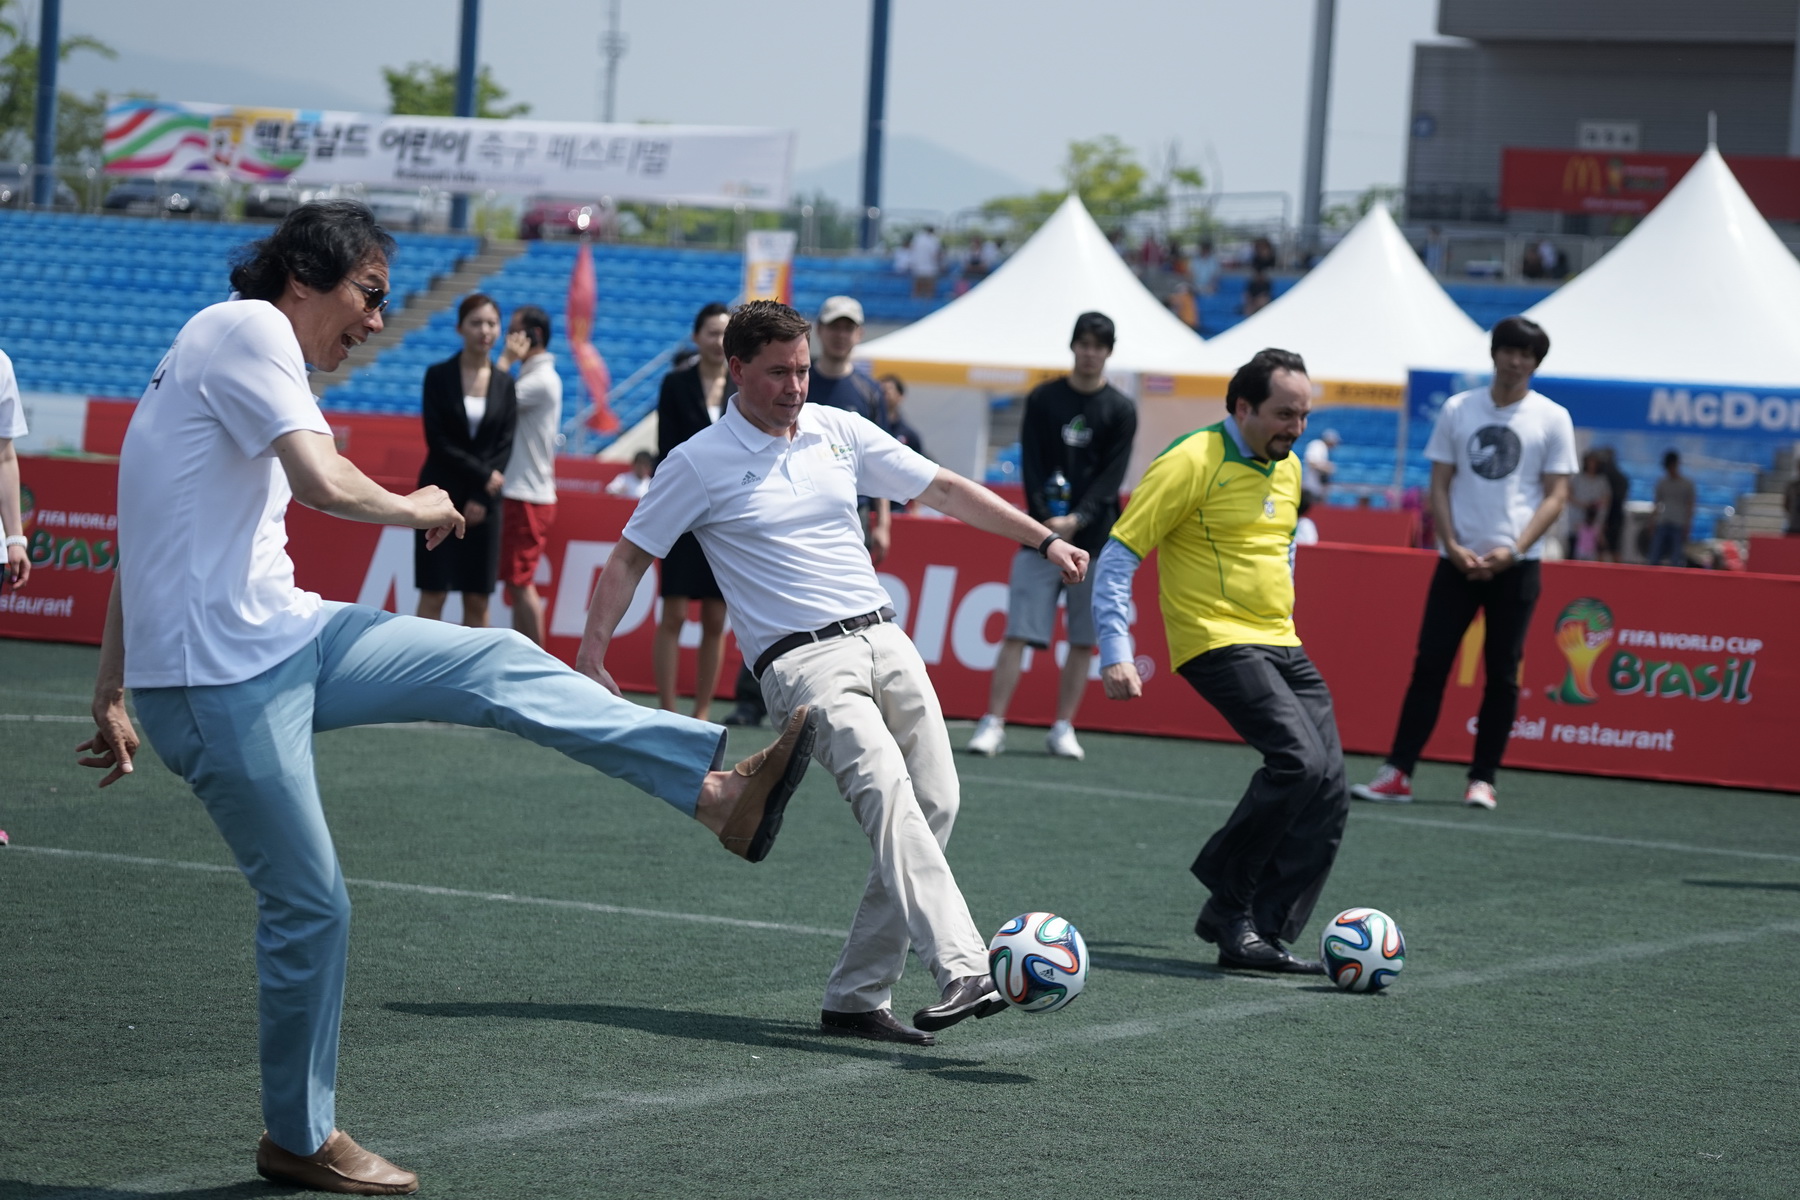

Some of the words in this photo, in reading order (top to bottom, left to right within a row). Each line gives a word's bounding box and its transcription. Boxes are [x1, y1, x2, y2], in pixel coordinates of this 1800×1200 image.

[254, 118, 371, 160] 맥도날드
[380, 124, 471, 165] 어린이
[478, 129, 539, 172] 축구
[545, 131, 673, 179] 페스티벌
[37, 509, 67, 527] FIFA
[68, 511, 118, 531] WORLD
[28, 528, 119, 574] Bras
[0, 591, 74, 617] staurant
[1617, 629, 1657, 648] FIFA
[1658, 632, 1725, 653] WORLD
[1725, 636, 1763, 655] CUP
[1608, 650, 1756, 704] Brasil
[1551, 722, 1675, 752] restaurant
